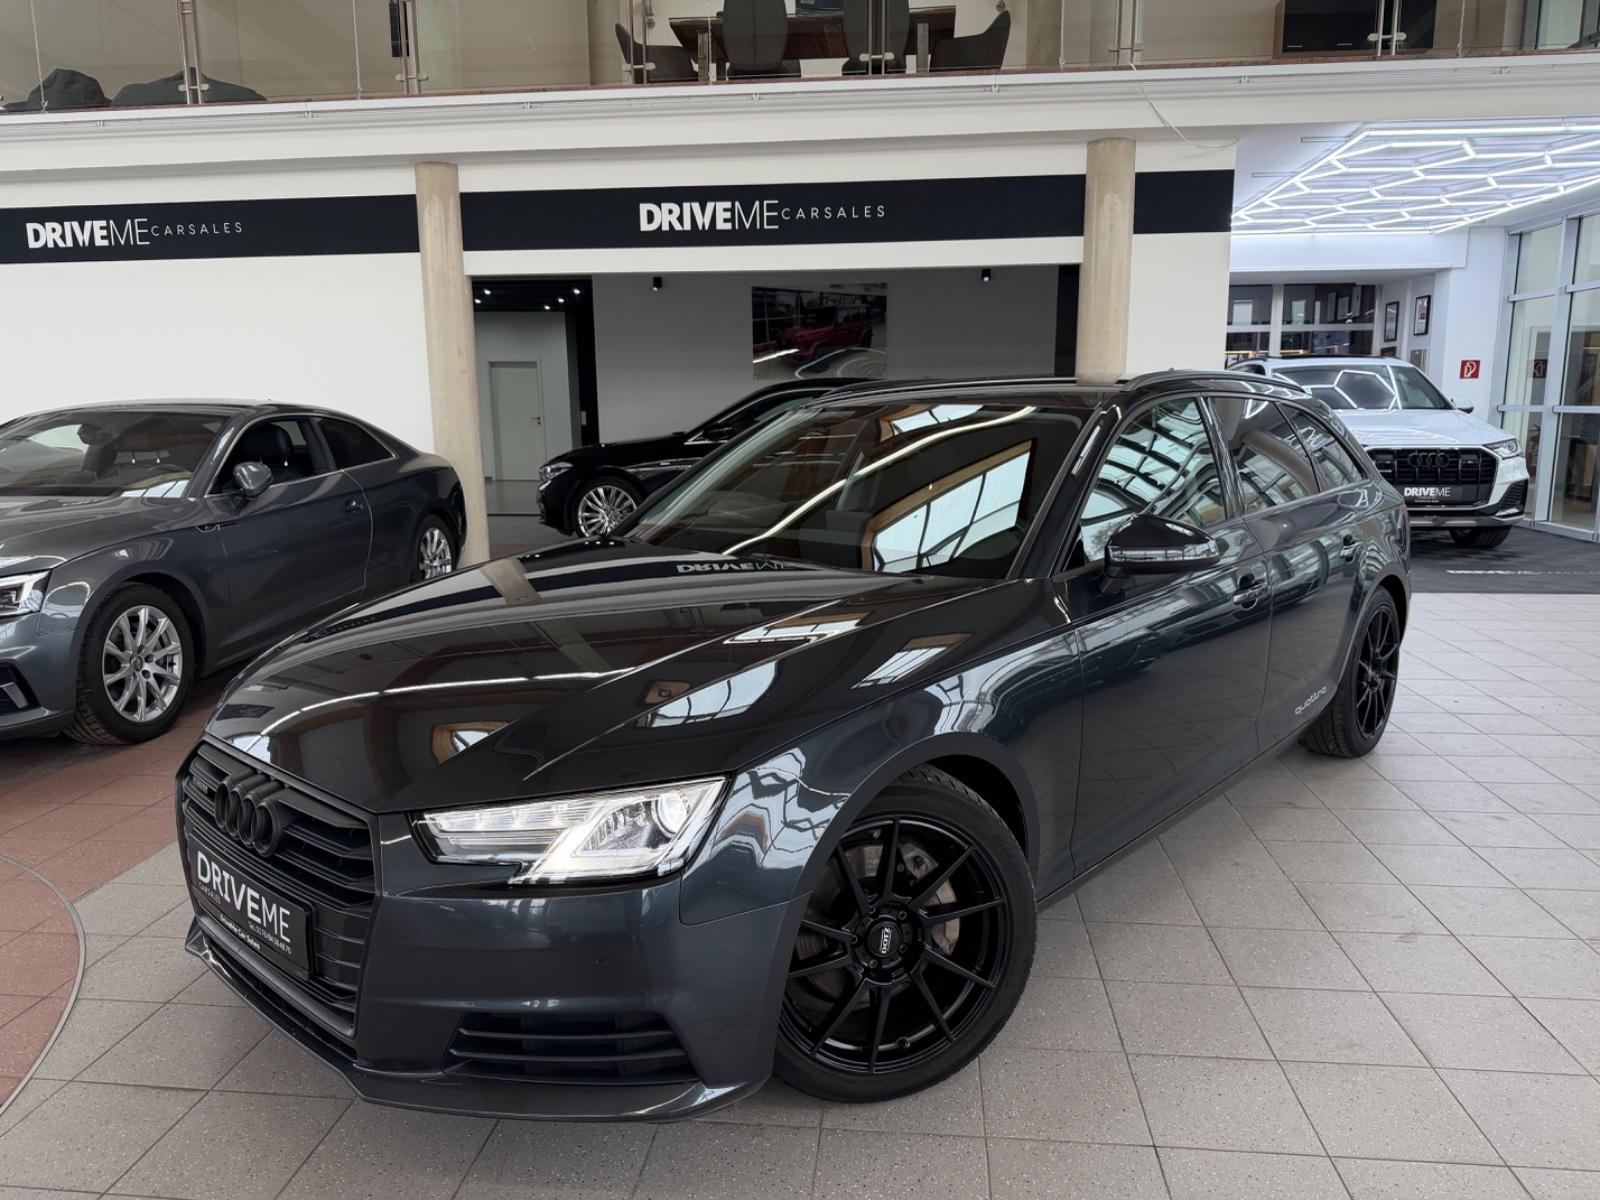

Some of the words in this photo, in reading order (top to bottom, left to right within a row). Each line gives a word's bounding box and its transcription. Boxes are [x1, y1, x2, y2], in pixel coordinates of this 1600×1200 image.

[638, 200, 779, 231] DRIVEME
[781, 205, 886, 220] CARSALES
[26, 218, 150, 249] DRIVEME
[151, 222, 243, 236] CARSALES
[1404, 487, 1451, 497] DRIVEME
[1295, 686, 1327, 715] quattro
[198, 850, 291, 943] DRIVEME
